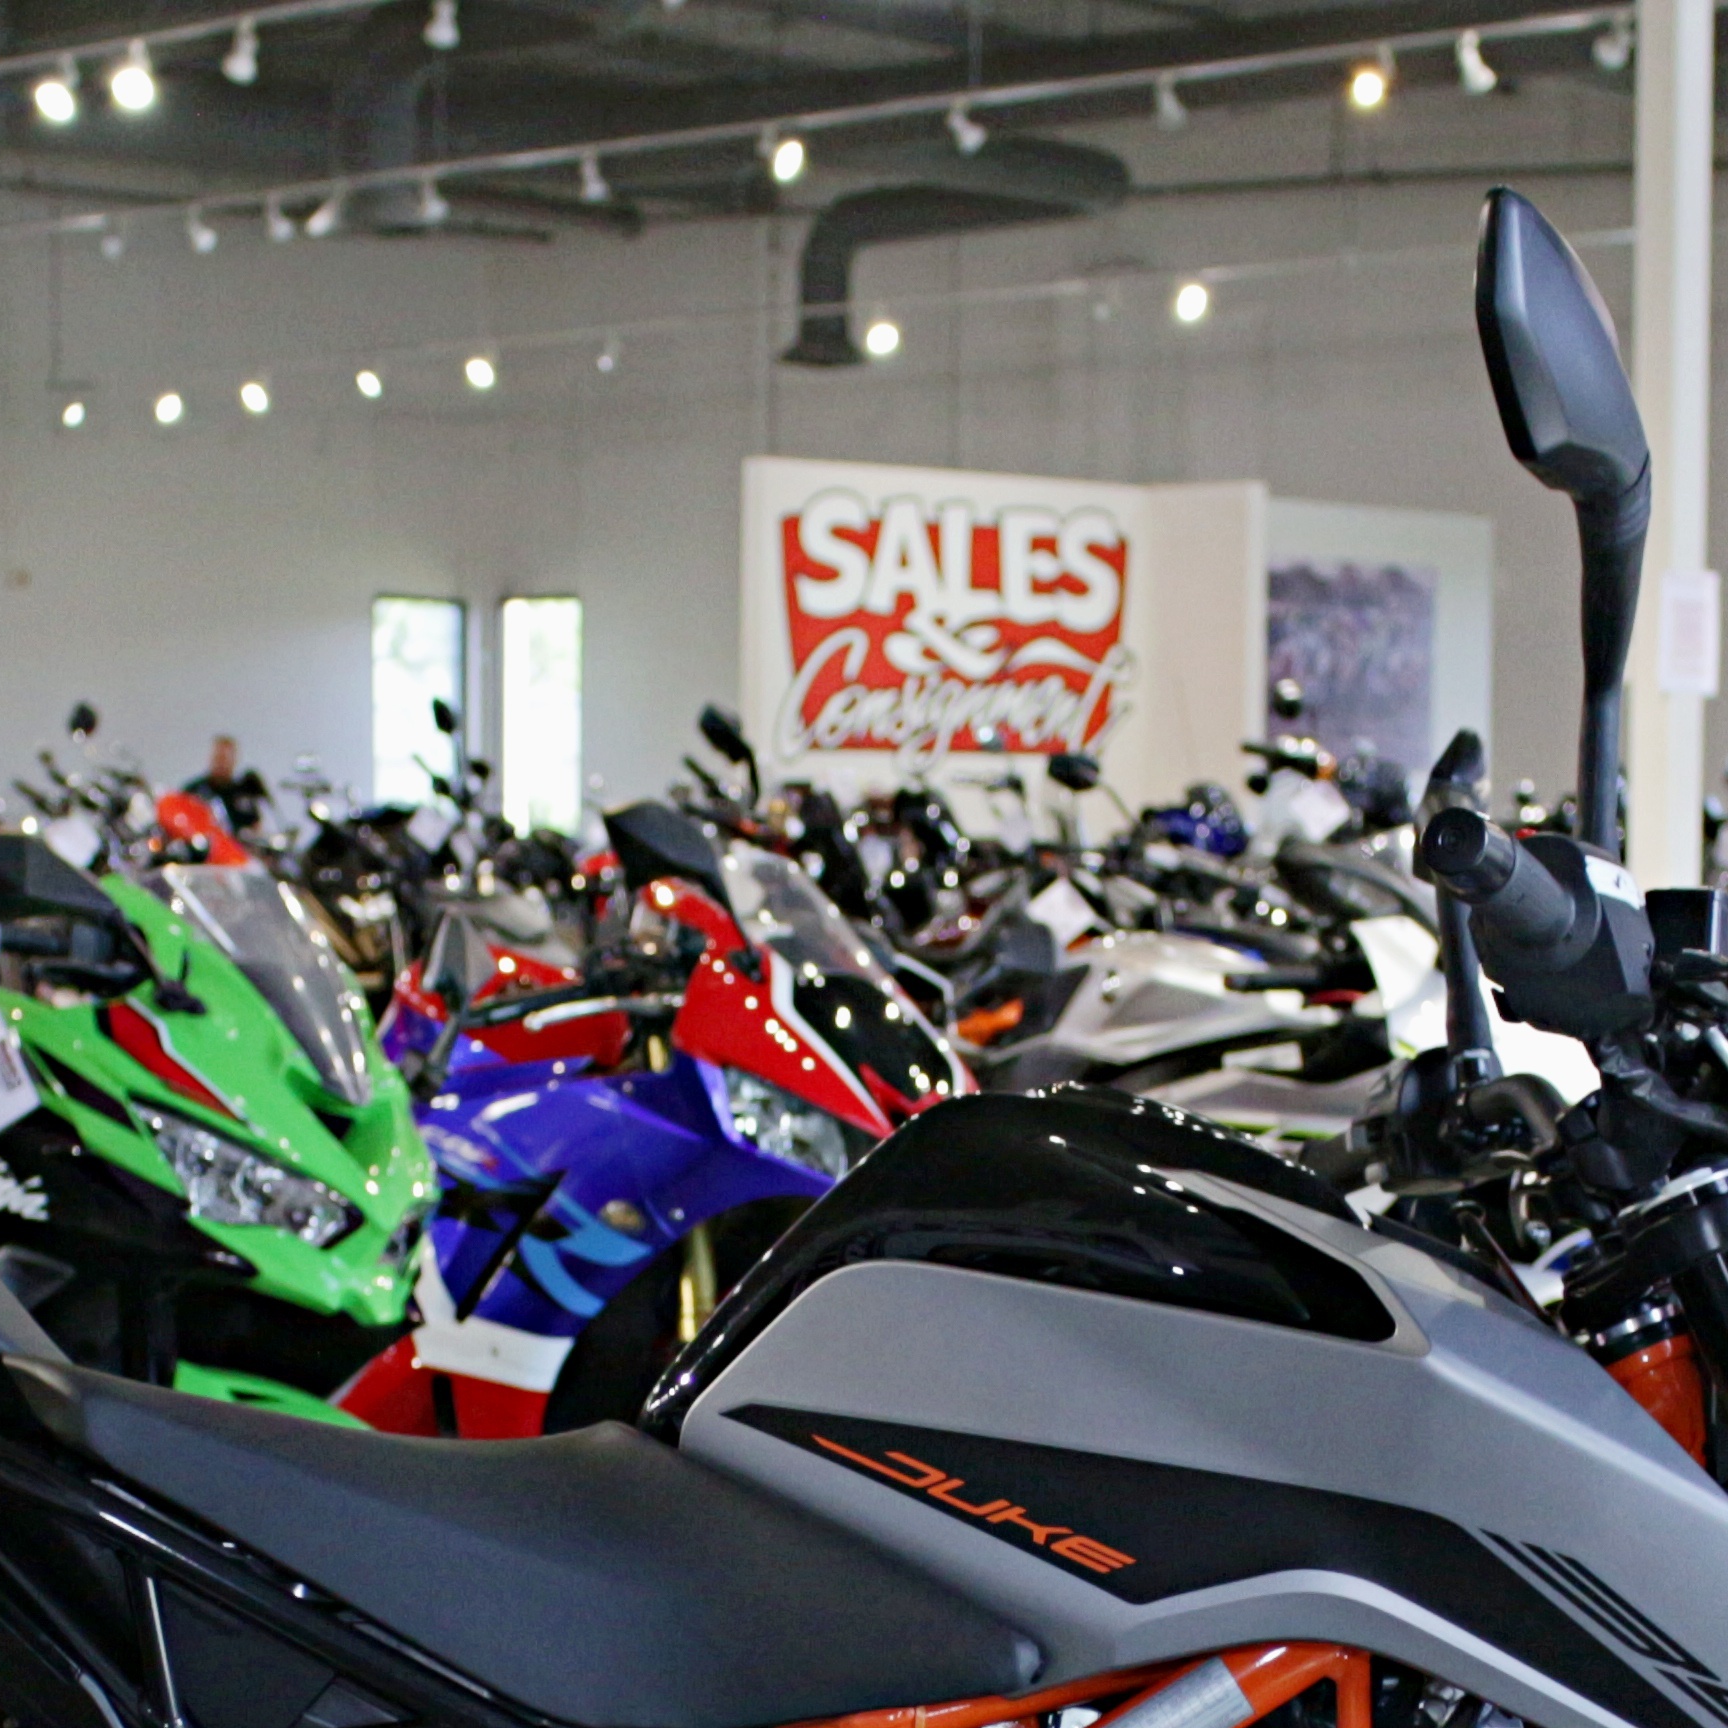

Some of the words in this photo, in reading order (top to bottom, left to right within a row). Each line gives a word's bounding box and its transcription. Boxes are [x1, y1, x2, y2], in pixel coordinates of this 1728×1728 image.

[793, 488, 1123, 634] SALES
[777, 628, 1134, 776] Consignment
[813, 1434, 1136, 1574] DUKE
